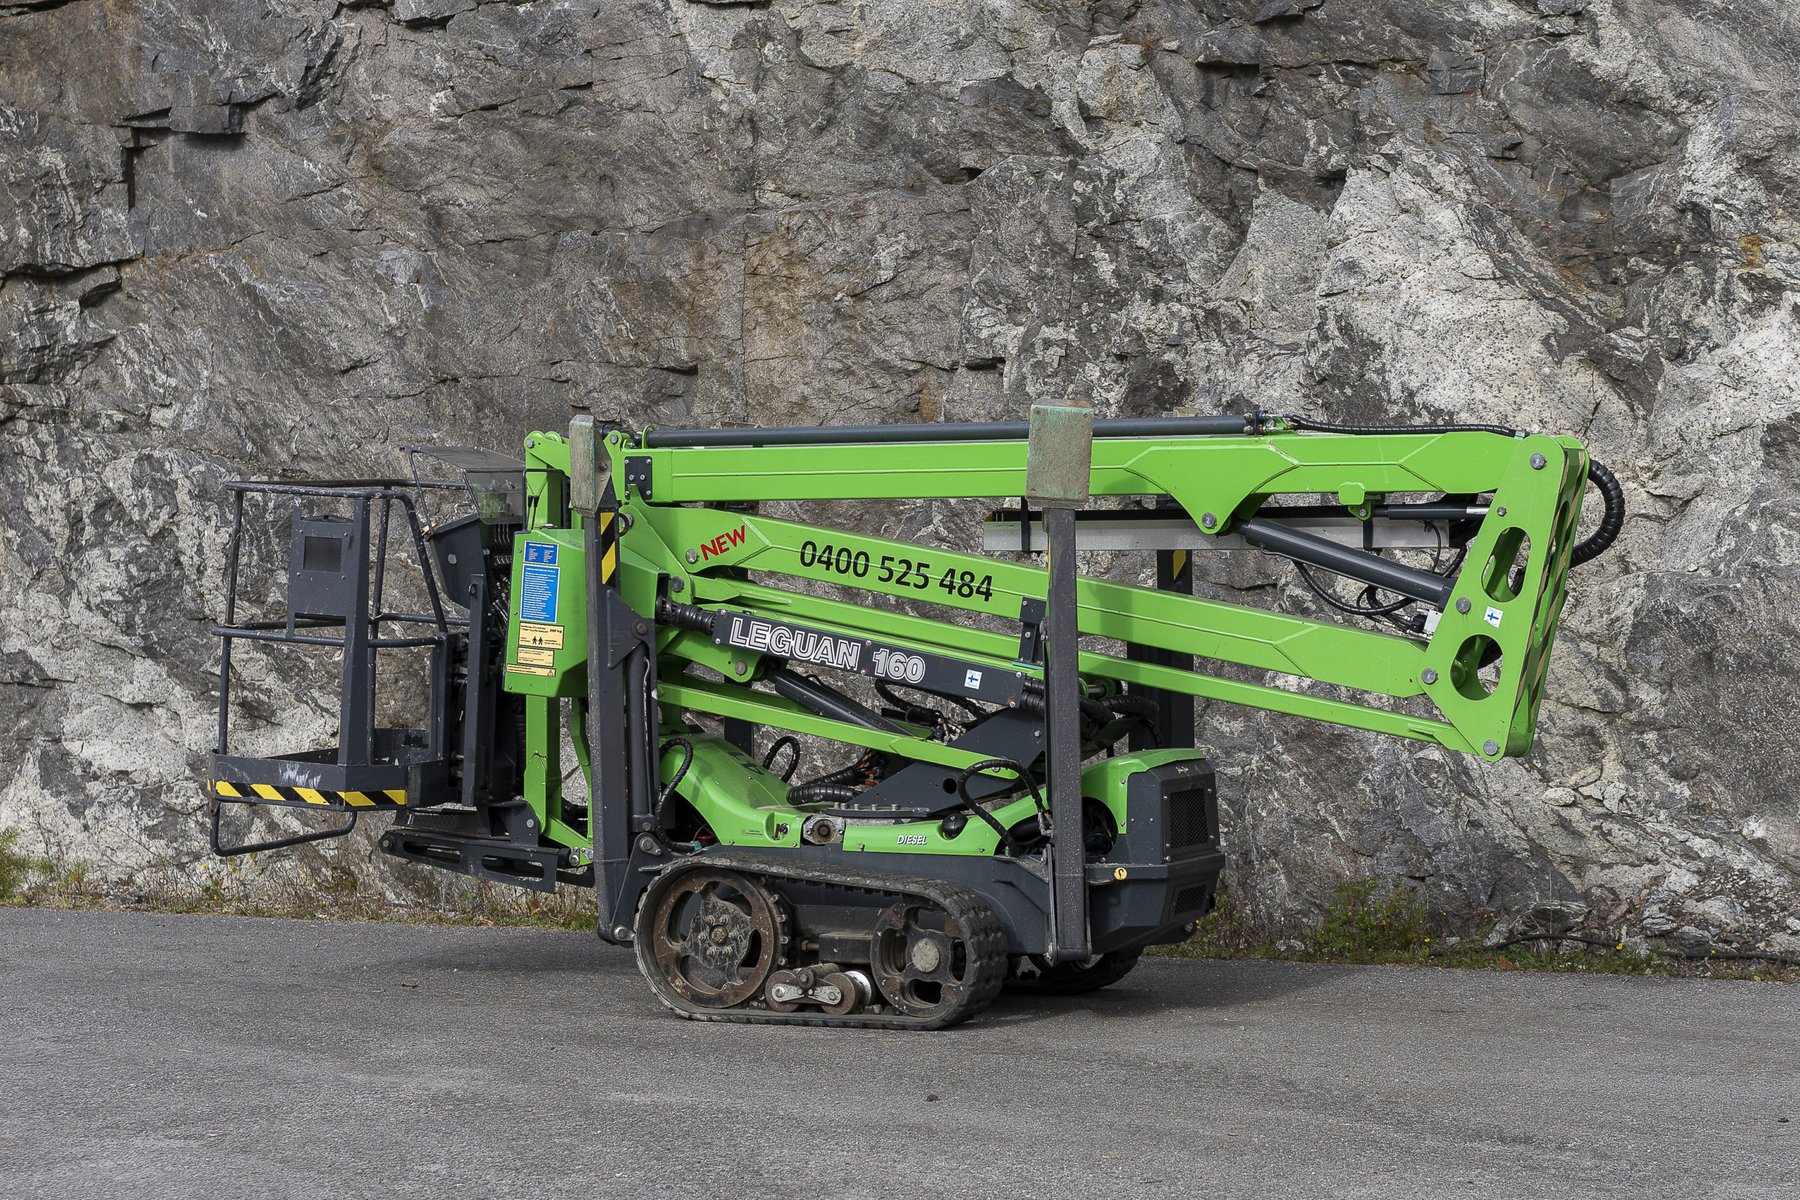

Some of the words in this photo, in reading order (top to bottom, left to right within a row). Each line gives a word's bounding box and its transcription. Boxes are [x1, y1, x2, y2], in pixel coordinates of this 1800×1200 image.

[700, 524, 745, 561] NEW
[799, 540, 870, 578] 0400
[877, 555, 931, 590] 525
[938, 568, 993, 602] 484
[729, 617, 861, 671] LEGUAN
[873, 648, 926, 684] 160
[897, 835, 928, 845] DIESEL
